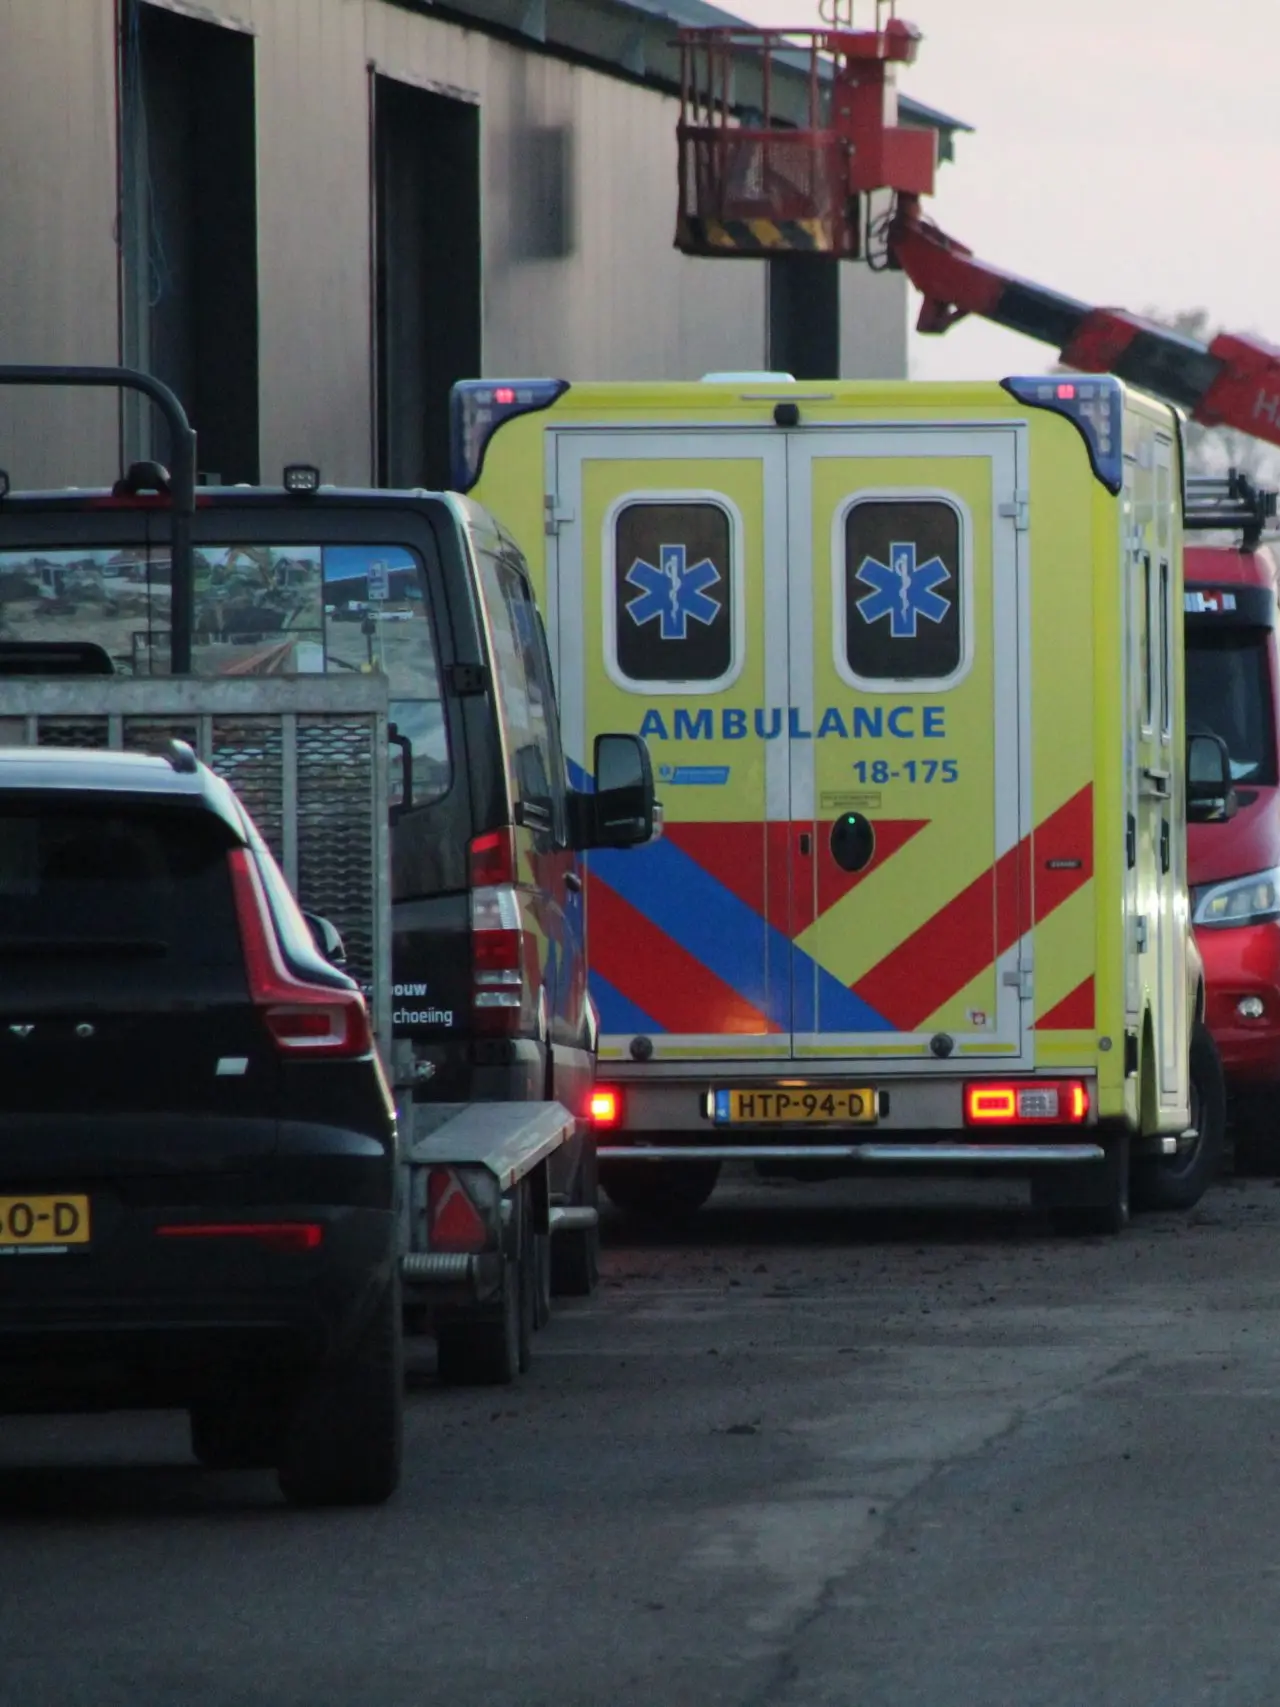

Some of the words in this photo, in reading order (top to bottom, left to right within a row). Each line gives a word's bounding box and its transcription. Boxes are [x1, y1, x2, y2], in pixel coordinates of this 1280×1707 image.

[638, 706, 947, 740] AMBULANCE
[853, 760, 958, 783] 18-175
[738, 1094, 864, 1117] HTP-94-D
[0, 1202, 79, 1237] 0-D
